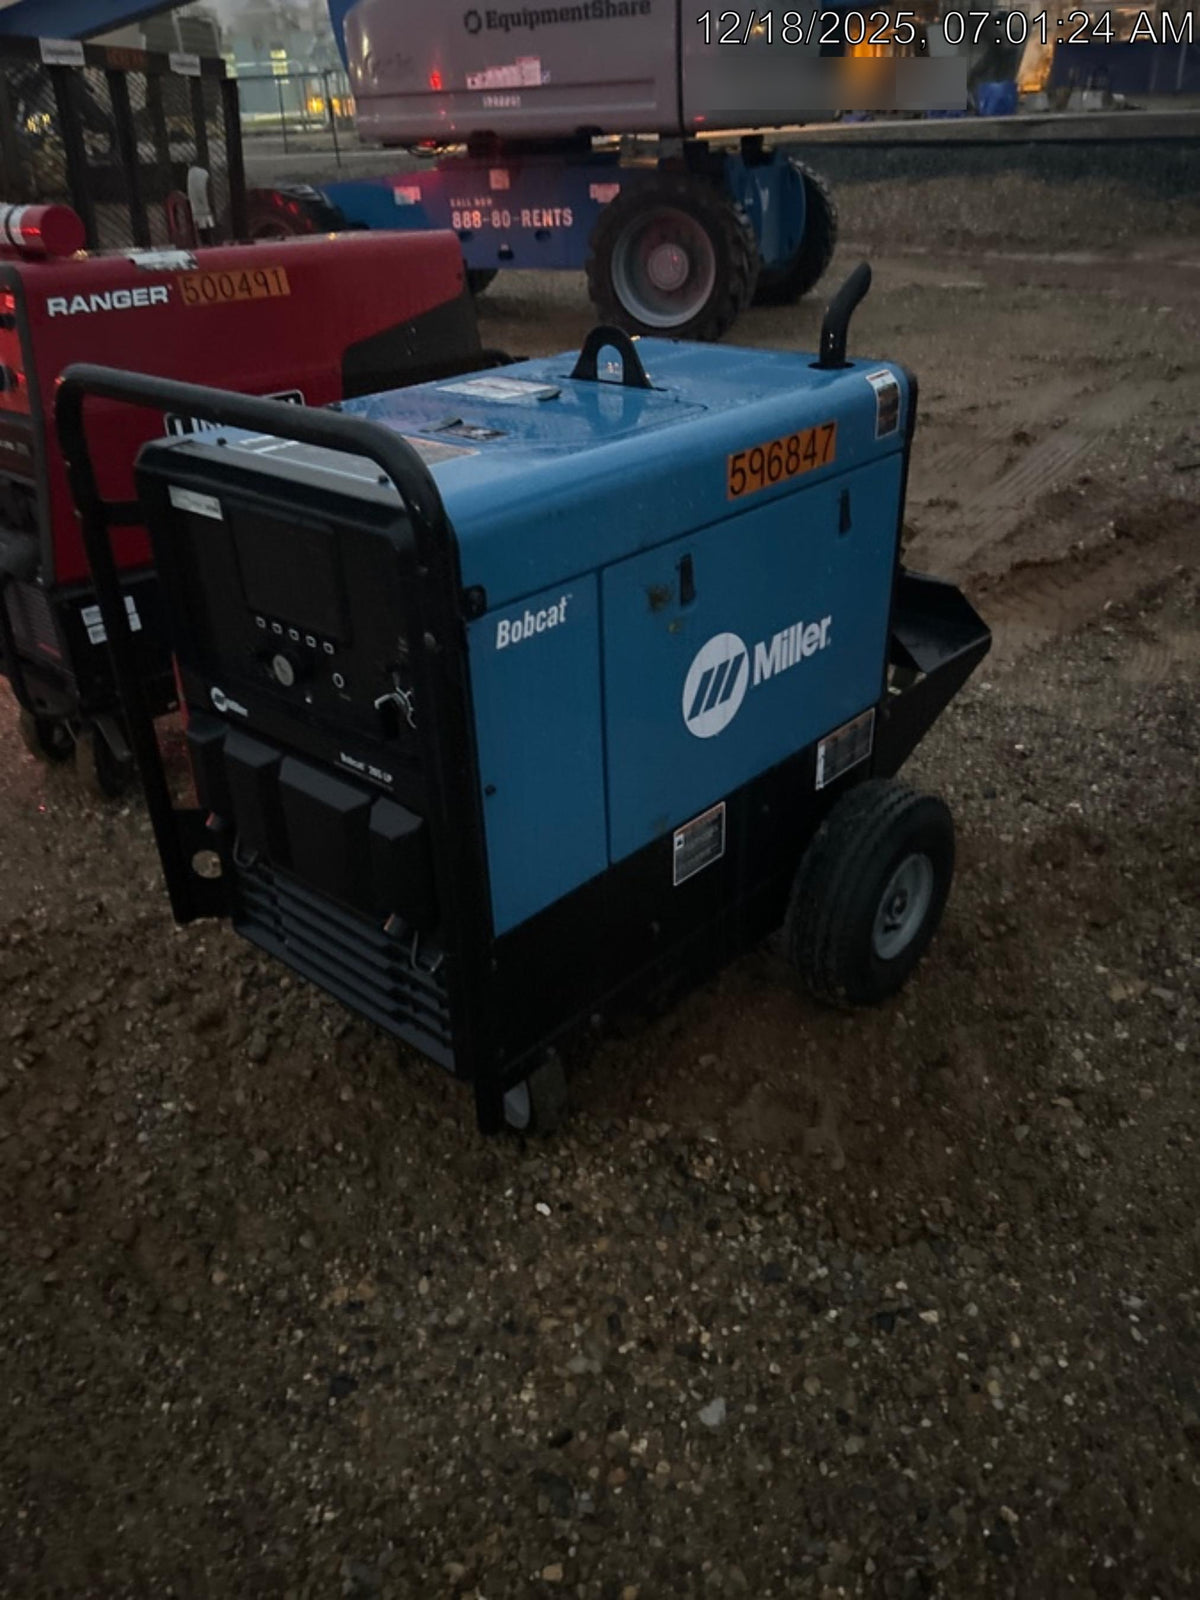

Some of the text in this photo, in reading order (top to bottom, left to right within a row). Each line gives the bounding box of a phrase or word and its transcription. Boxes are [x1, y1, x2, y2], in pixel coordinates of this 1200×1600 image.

[486, 0, 651, 32] EquipmentShare
[46, 284, 170, 318] RANGER
[182, 269, 287, 304] 500491
[730, 422, 836, 495] 596847
[495, 595, 568, 651] Bobcat
[752, 614, 832, 687] Miller
